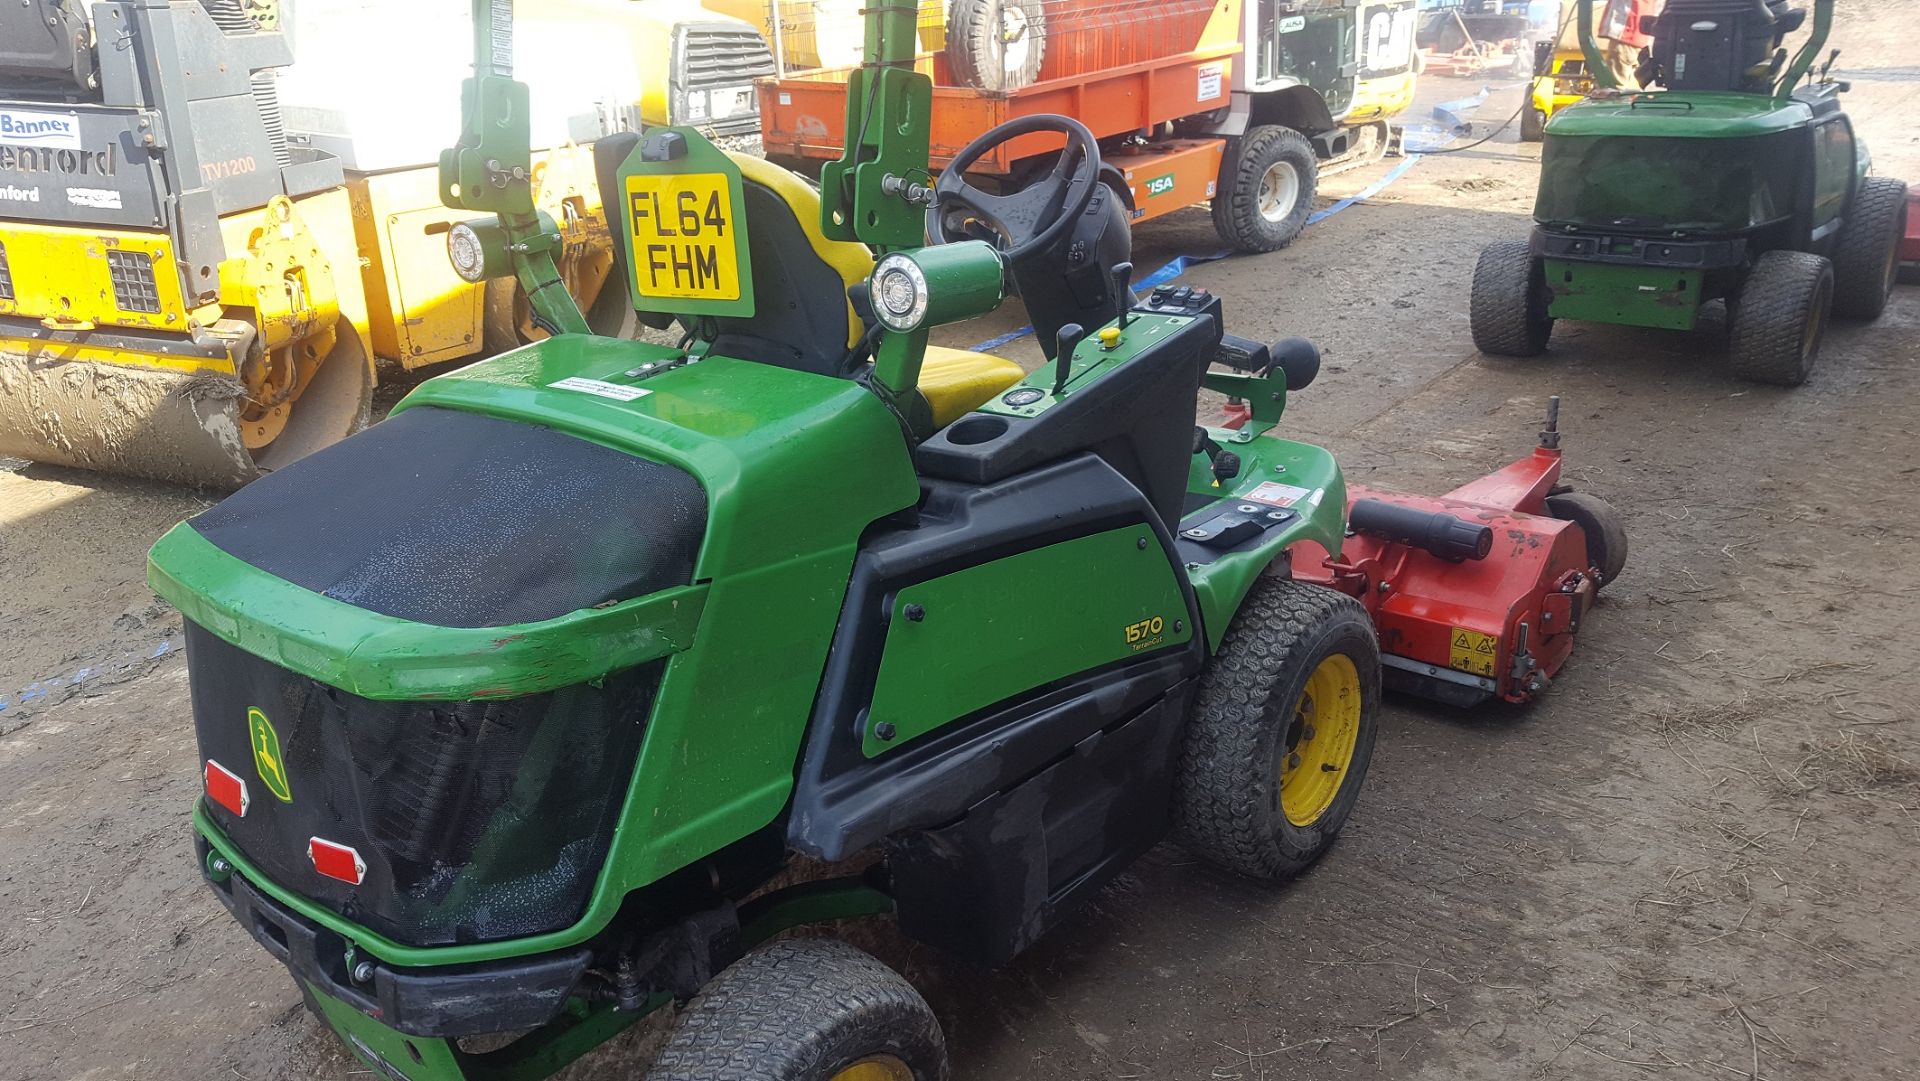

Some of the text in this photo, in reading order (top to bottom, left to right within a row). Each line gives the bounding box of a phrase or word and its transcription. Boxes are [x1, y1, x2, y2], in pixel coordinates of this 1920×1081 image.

[0, 114, 70, 134] Banner
[202, 156, 256, 181] TV1200
[630, 190, 726, 237] FL64
[647, 244, 720, 290] FHM
[1125, 616, 1163, 643] 1570
